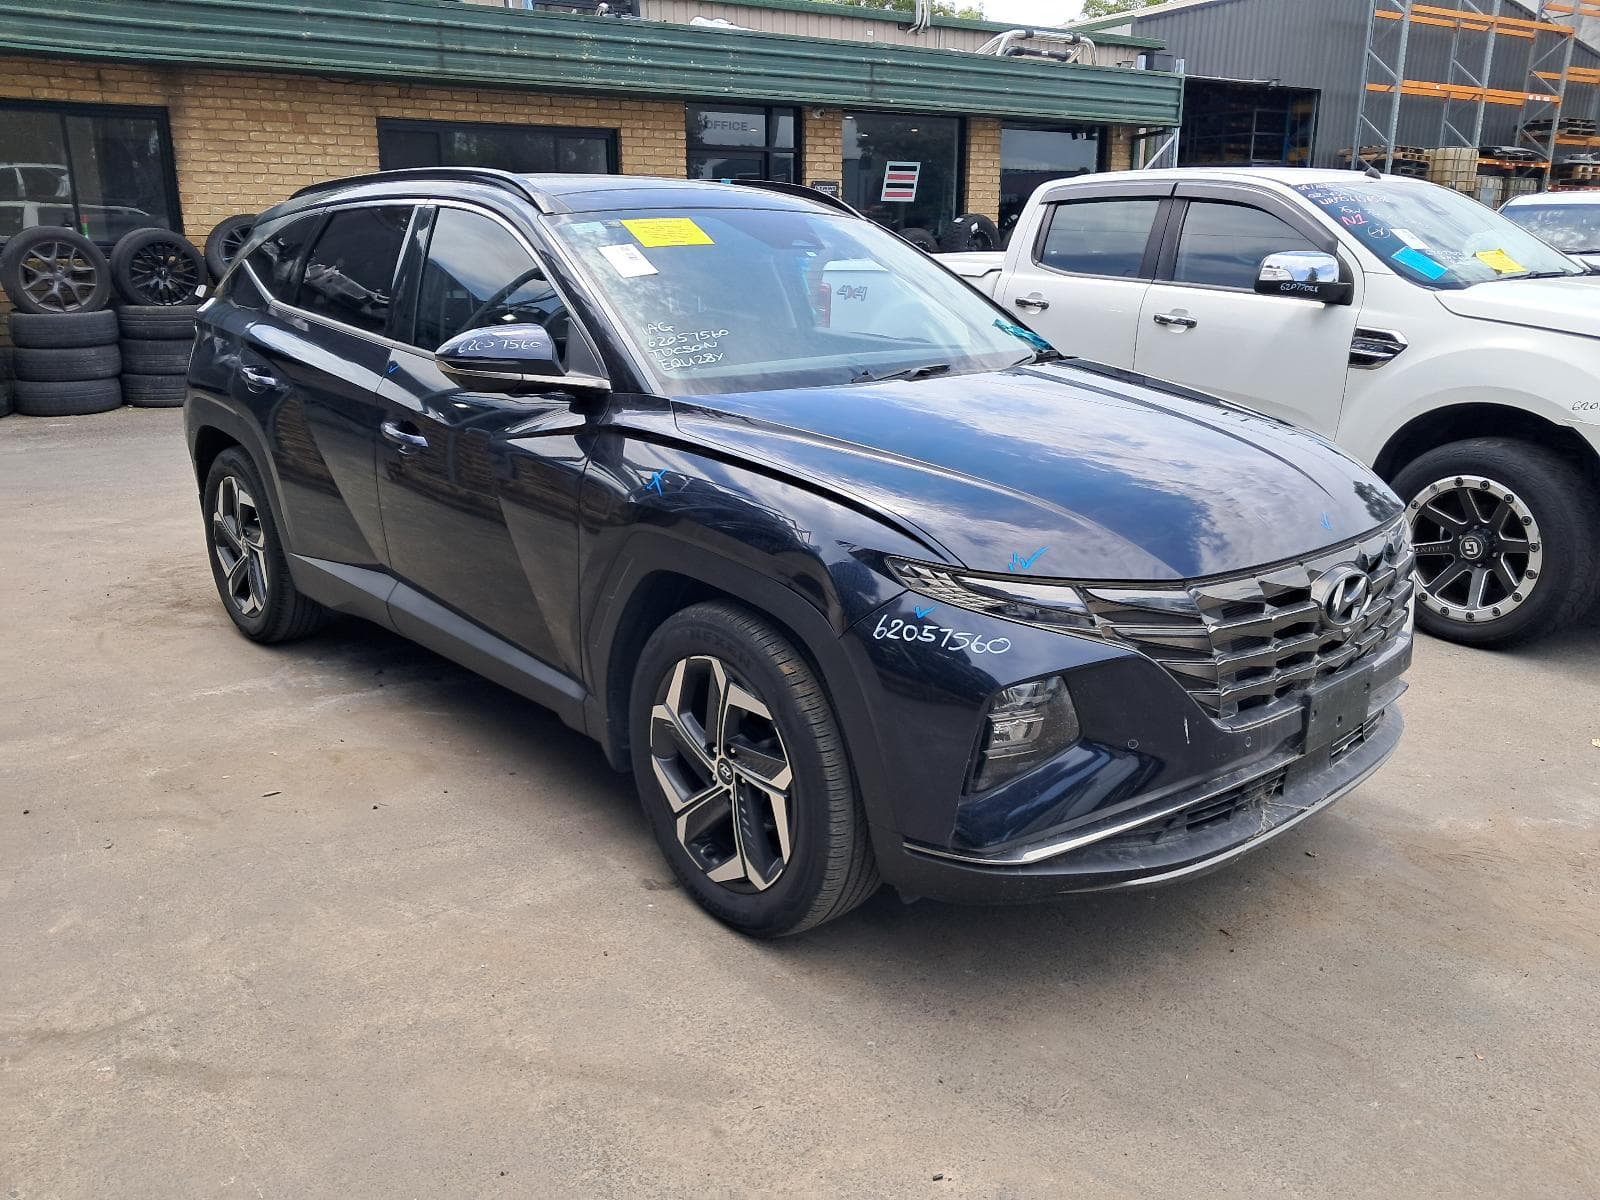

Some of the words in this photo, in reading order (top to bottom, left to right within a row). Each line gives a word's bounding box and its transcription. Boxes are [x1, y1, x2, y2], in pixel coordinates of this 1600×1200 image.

[704, 120, 748, 131] OFFICE
[1571, 400, 1600, 411] 620
[872, 614, 1012, 654] 62057560
